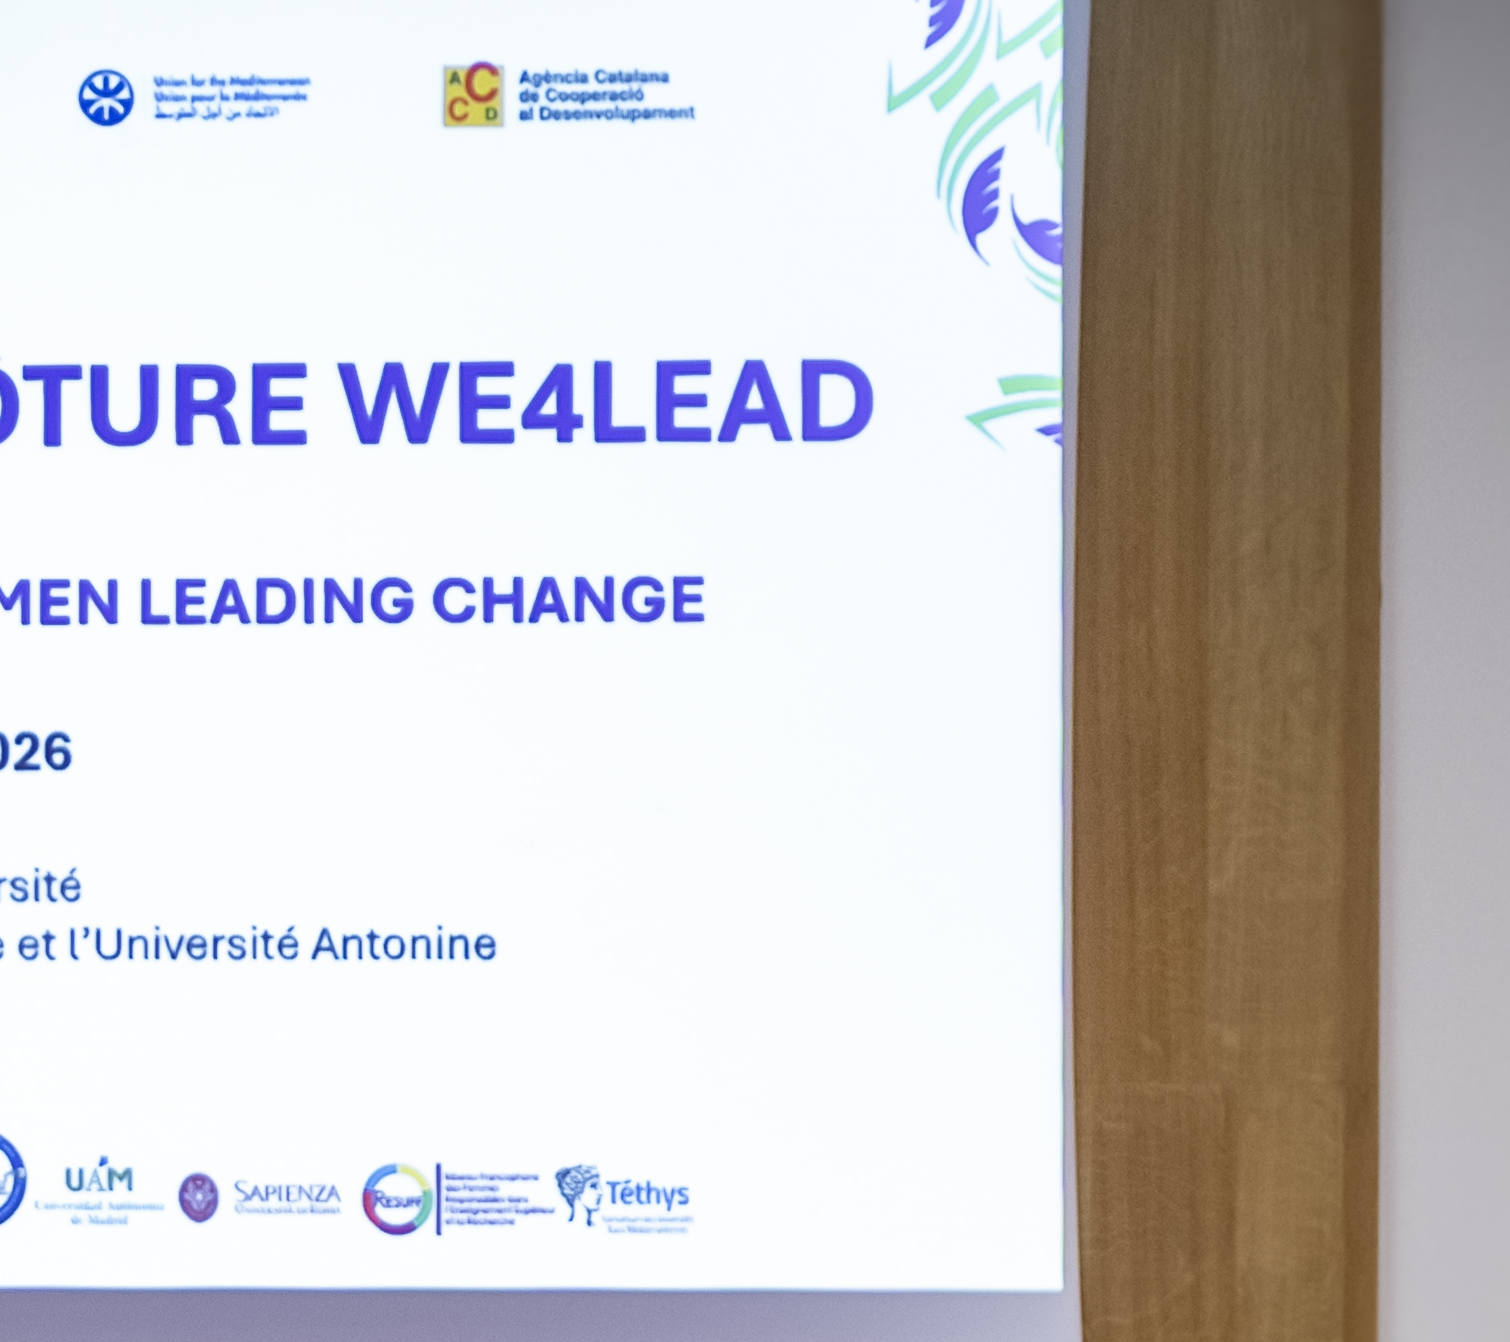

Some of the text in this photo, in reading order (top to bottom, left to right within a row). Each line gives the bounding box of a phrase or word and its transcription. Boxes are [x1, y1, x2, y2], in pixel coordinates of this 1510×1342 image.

[519, 68, 670, 88] Agència Catalana
[519, 86, 644, 105] de Cooperació
[519, 105, 696, 122] al Desenvolupament
[336, 358, 874, 445] WE4LEAD
[140, 576, 415, 626] LEADING
[432, 575, 705, 624] CHANGE
[17, 930, 56, 962] et
[69, 925, 299, 961] l’Université
[310, 925, 497, 961] Antonine
[233, 1180, 342, 1204] SAPIENZA
[606, 1179, 690, 1212] Téthys
